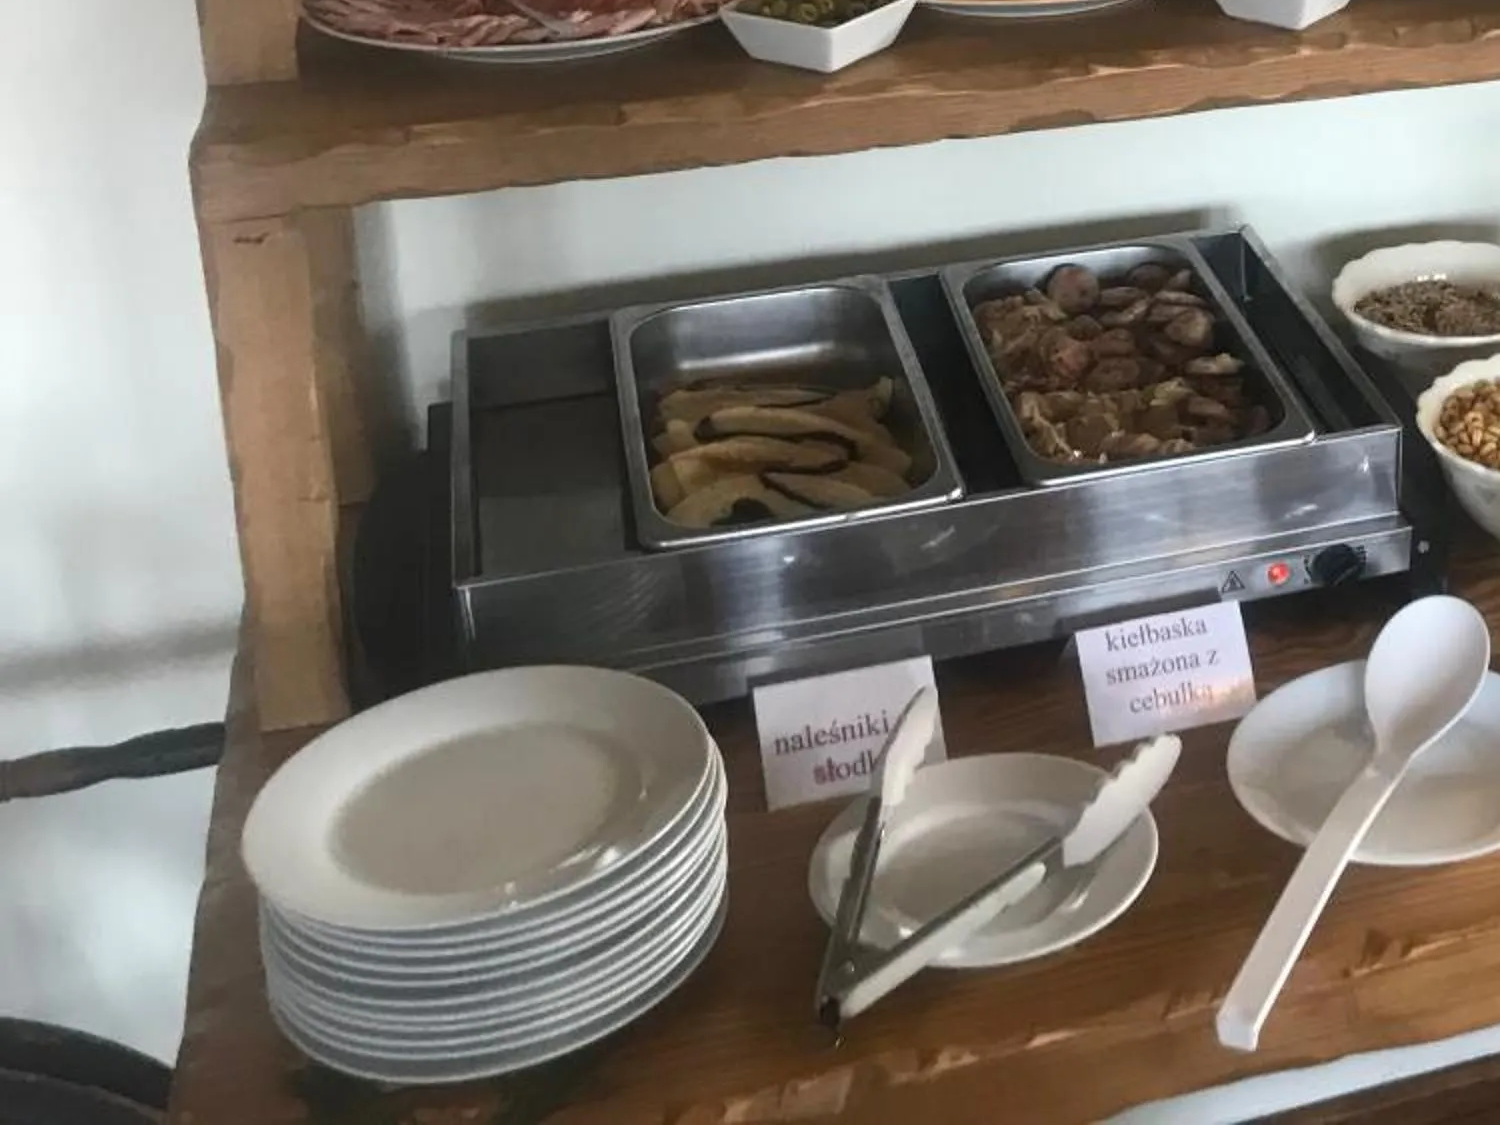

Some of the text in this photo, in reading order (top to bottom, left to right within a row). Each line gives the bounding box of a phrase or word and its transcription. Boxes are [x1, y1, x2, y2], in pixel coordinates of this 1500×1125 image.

[1106, 649, 1221, 686] smażona z
[774, 709, 890, 755] naleśniki
[813, 749, 878, 785] słod
